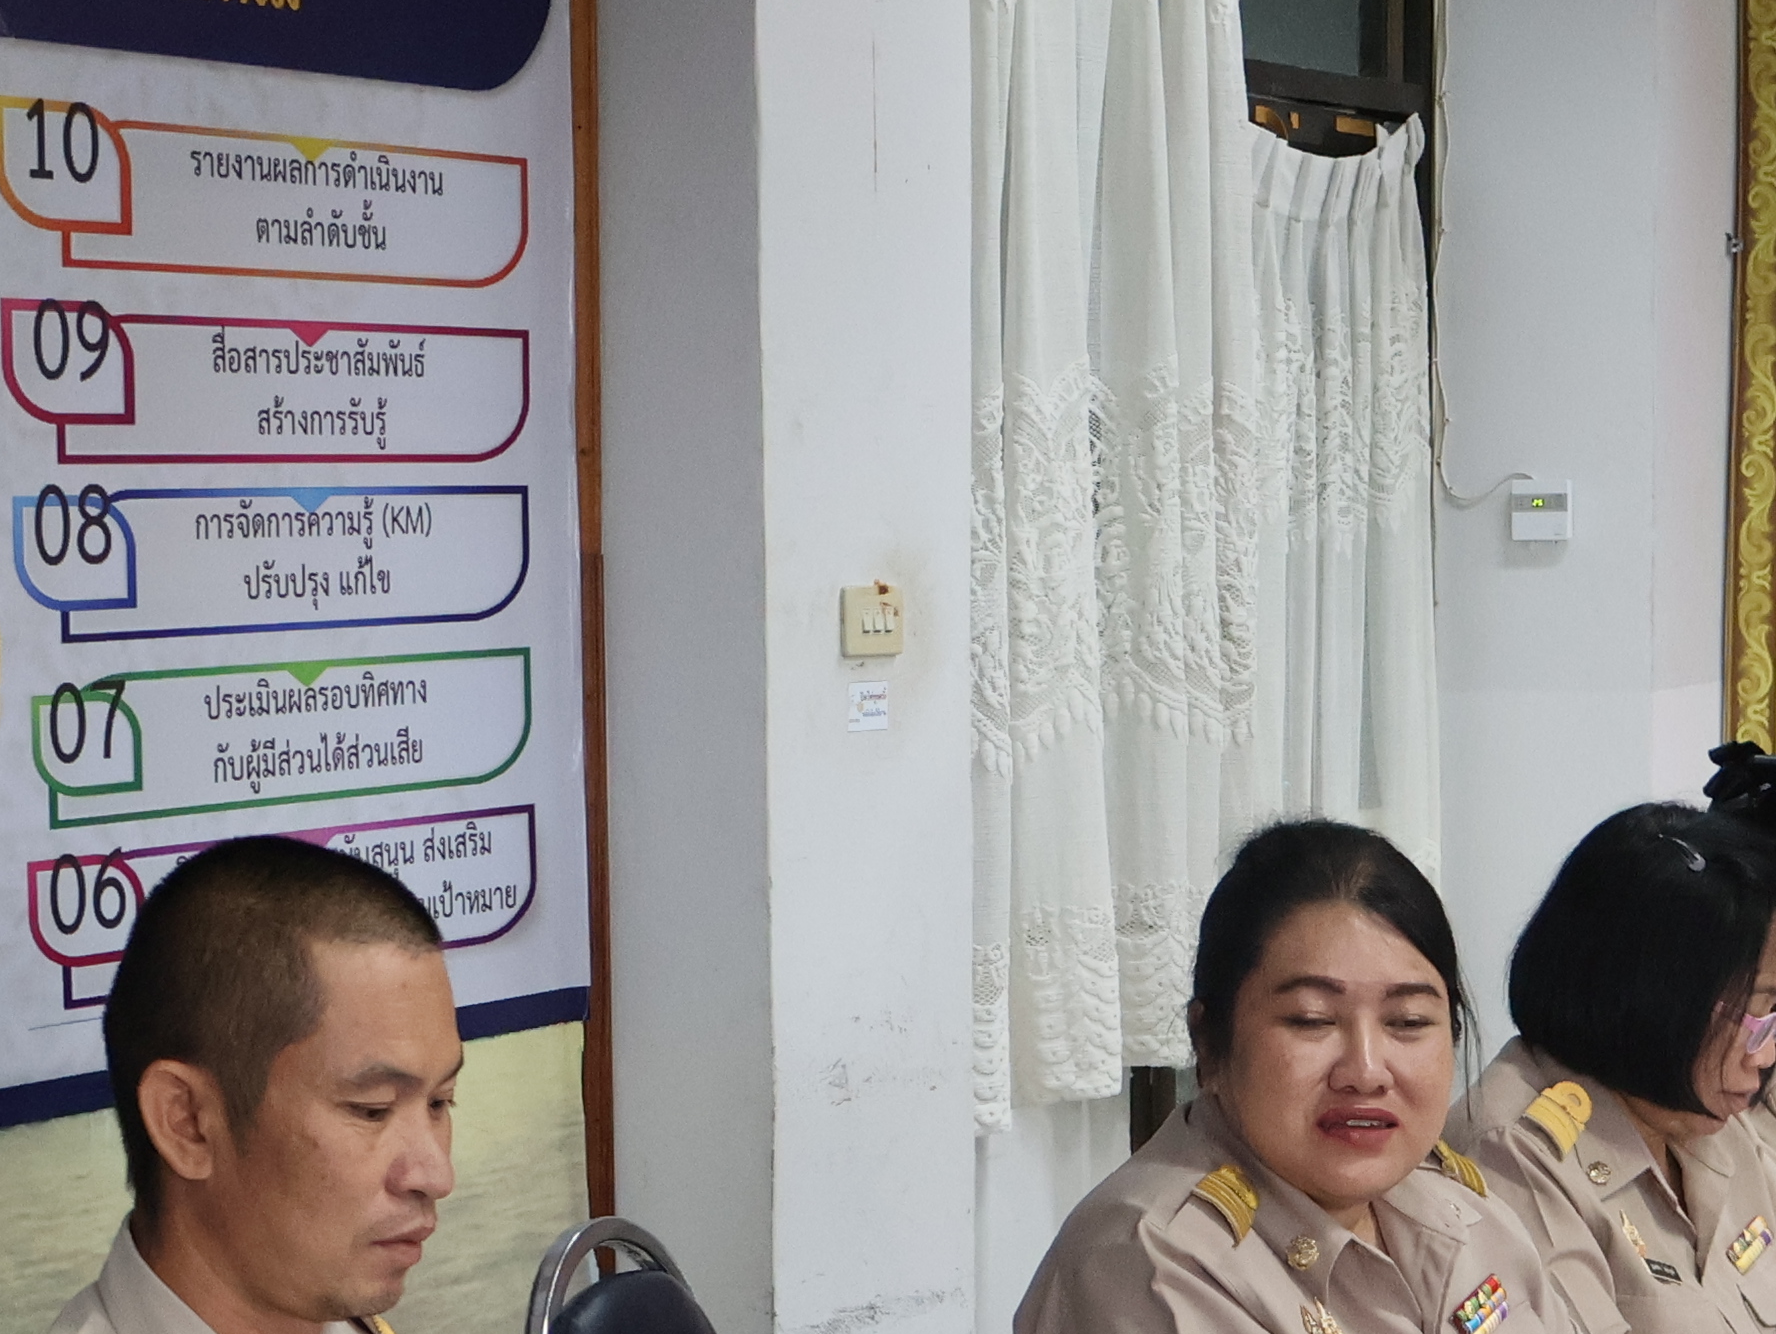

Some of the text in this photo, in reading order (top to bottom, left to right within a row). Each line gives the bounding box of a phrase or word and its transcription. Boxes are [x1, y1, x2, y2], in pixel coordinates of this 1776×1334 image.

[25, 98, 100, 183] 10
[190, 145, 445, 198] รายงานผลการดำเนินงาน
[255, 201, 387, 252] ตามลำดับชั้น
[33, 300, 111, 383] 09
[211, 332, 428, 380] สื่อสารประชาสัมพันธ์
[257, 398, 388, 451] สร้างการรับรู้
[35, 484, 113, 566] 08
[195, 502, 432, 548] การจัดการความรู้ (KM)
[244, 556, 392, 611] ปรับปรุง แก้ไข
[49, 680, 126, 764] 07
[203, 672, 428, 724] ประเมินผลรอบทิศทาง
[213, 734, 424, 795] กับผู้มีส่วนได้ส่วนเสีย
[423, 821, 492, 863] ส่งเสริม
[49, 851, 127, 936] 06
